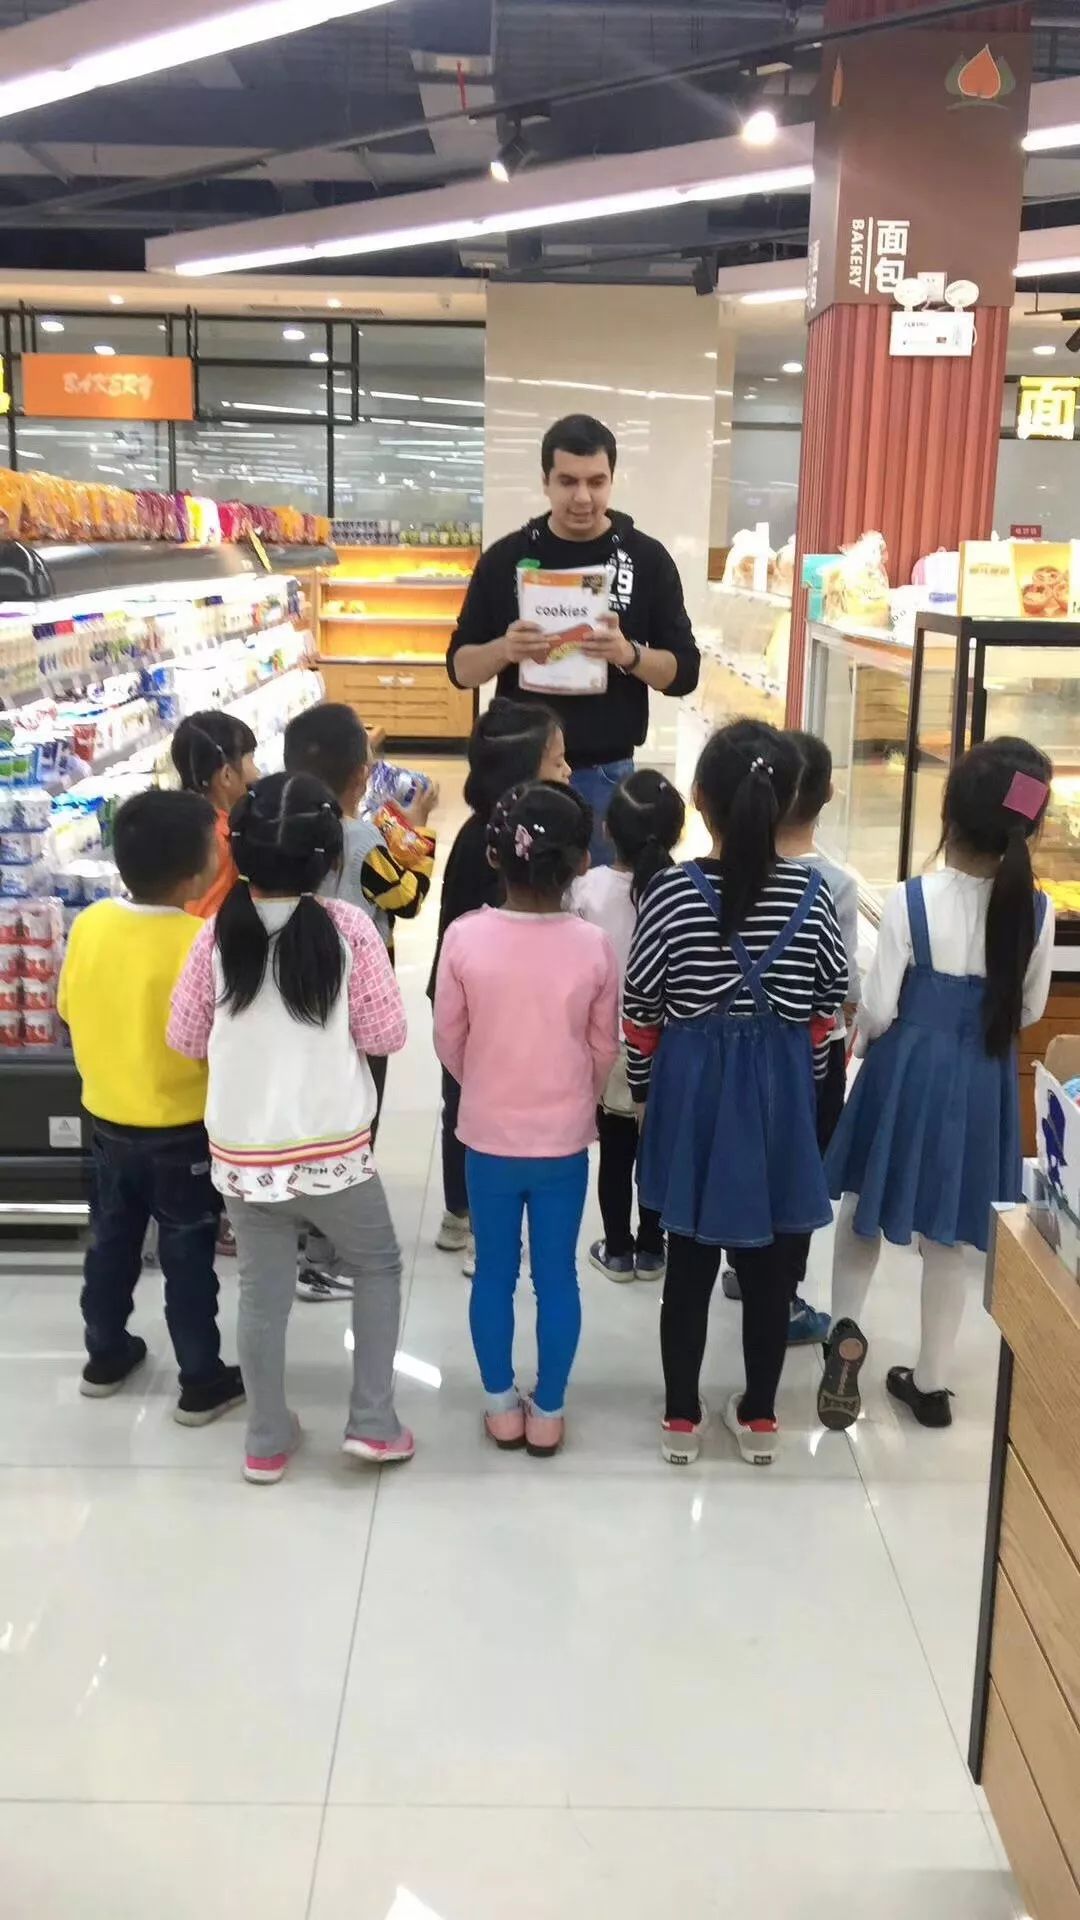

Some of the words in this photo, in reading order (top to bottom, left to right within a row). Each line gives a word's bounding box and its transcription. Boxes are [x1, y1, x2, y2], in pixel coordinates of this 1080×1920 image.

[849, 219, 866, 288] BAKERY
[874, 220, 911, 294] 面包
[1017, 376, 1080, 440] 面
[535, 604, 589, 617] cookies
